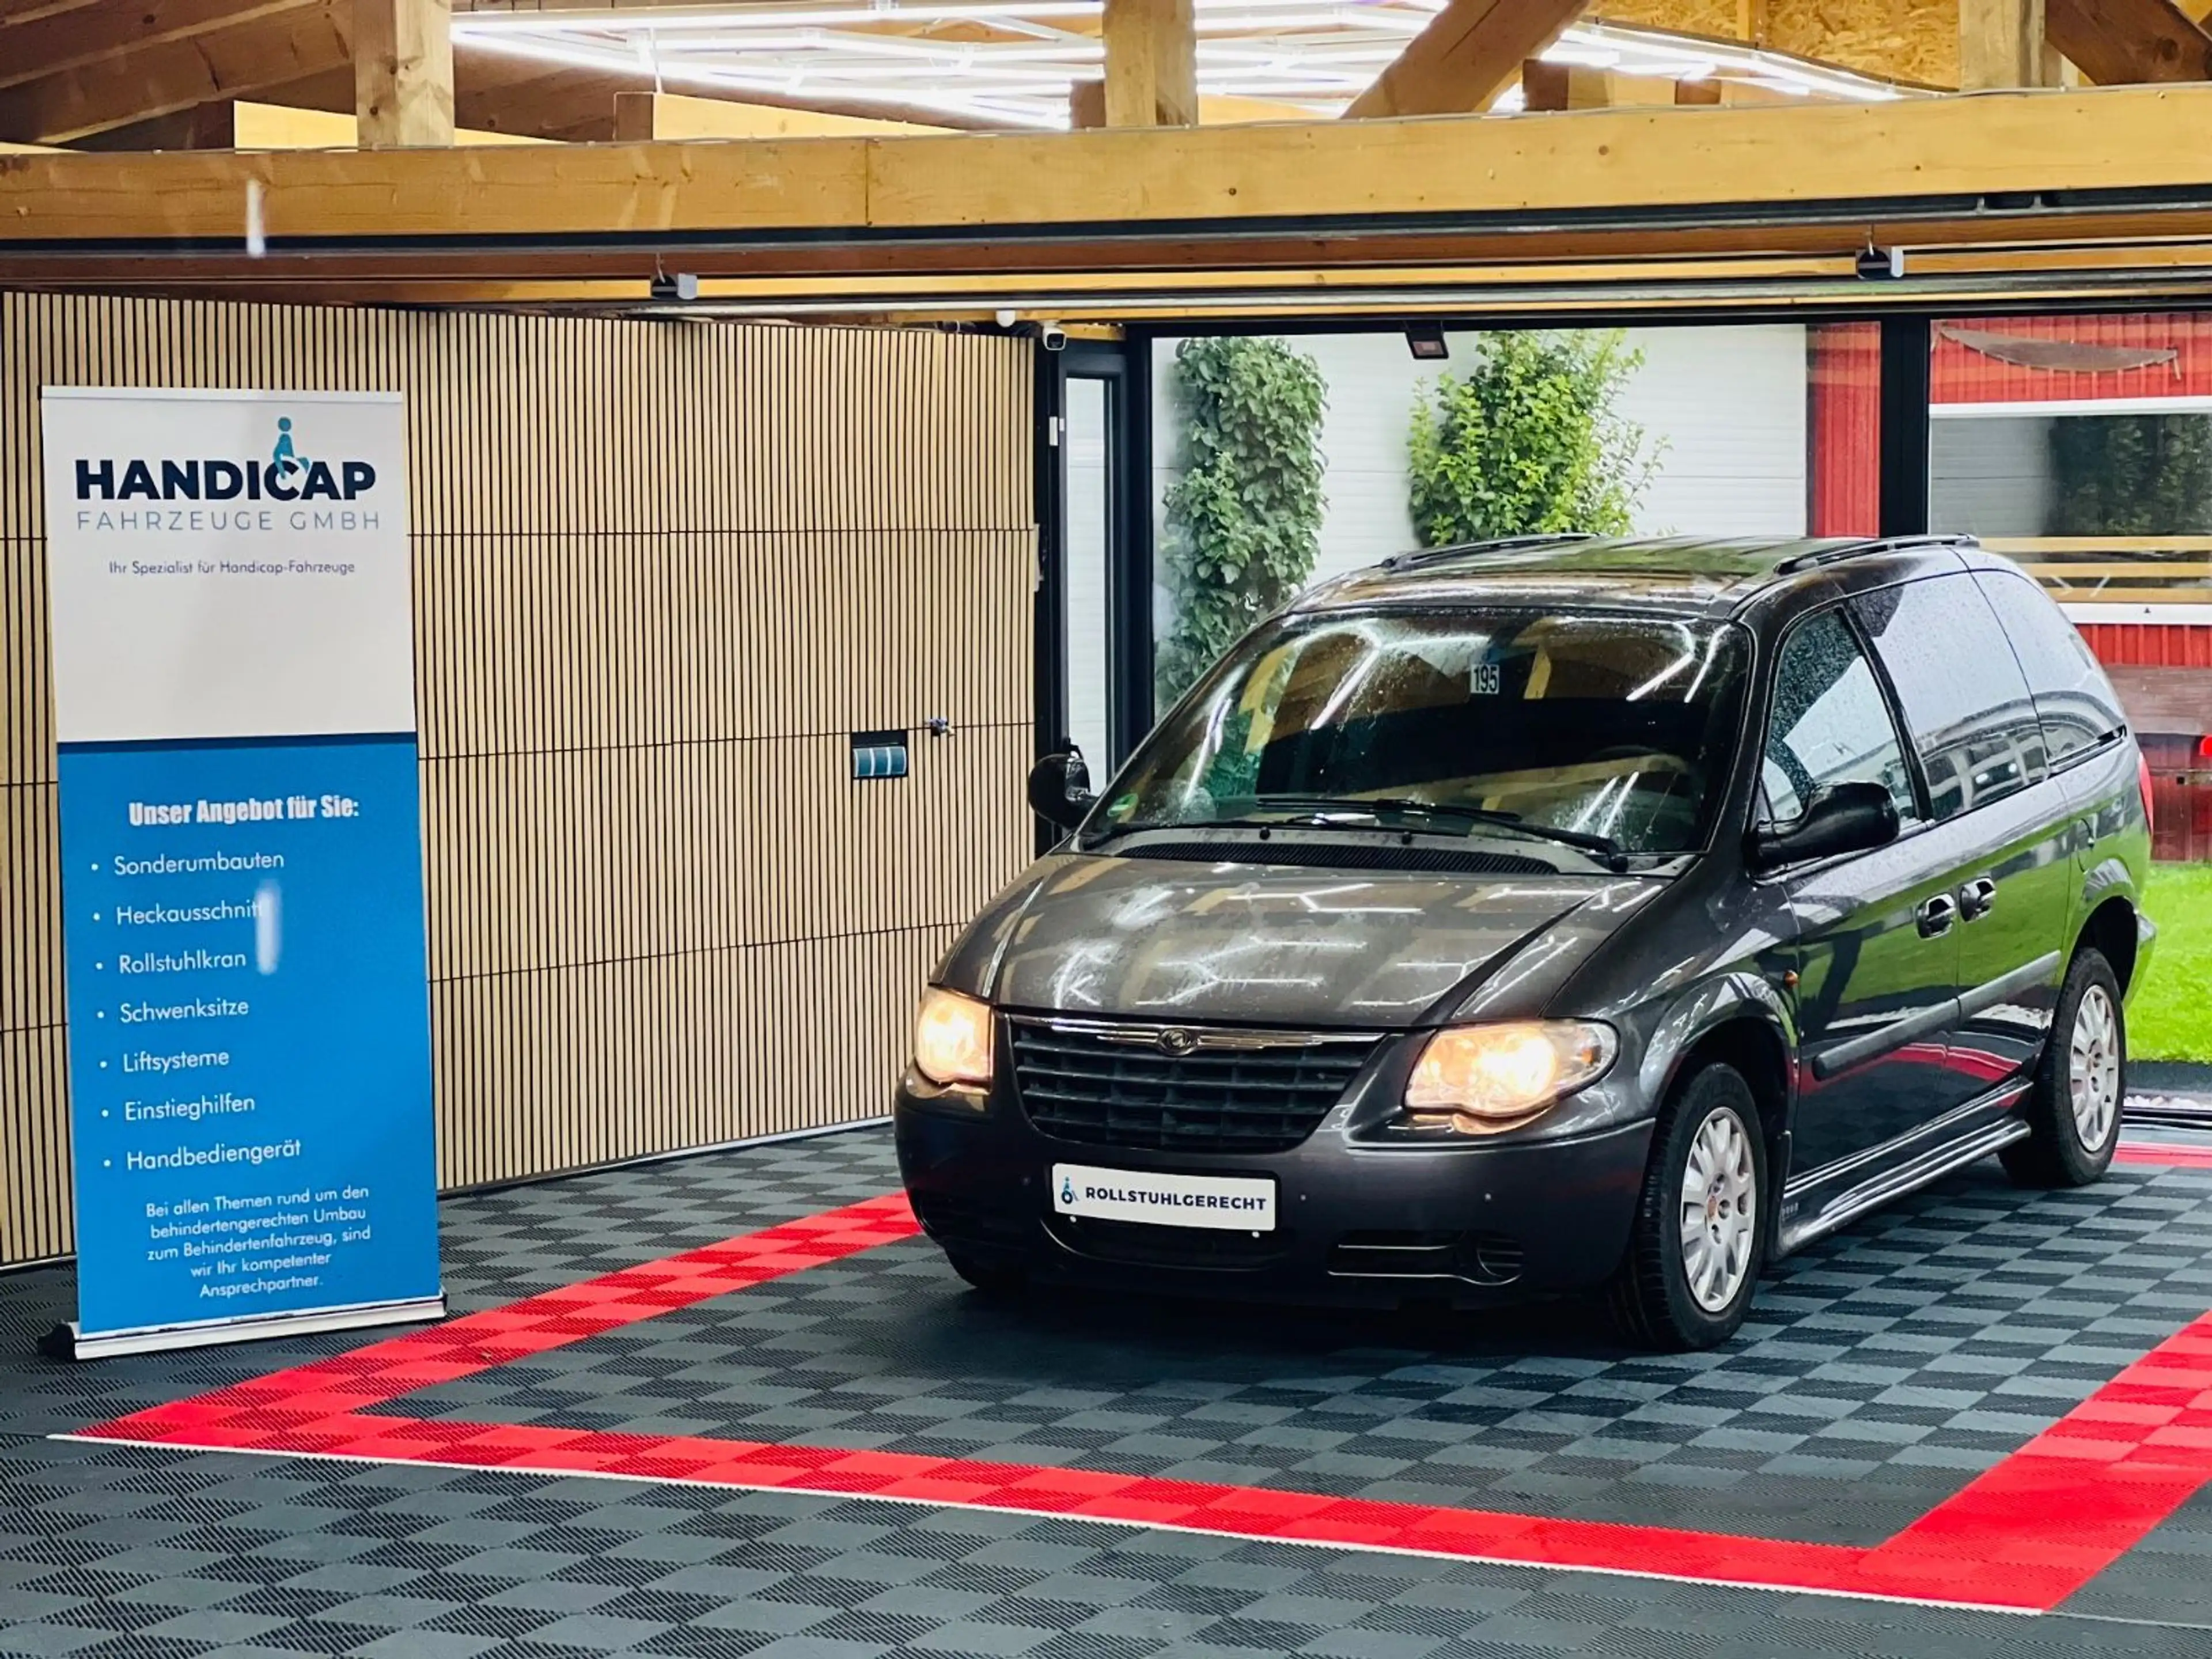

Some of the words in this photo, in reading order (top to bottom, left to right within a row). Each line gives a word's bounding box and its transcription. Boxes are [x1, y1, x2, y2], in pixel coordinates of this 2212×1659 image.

[75, 459, 376, 501] HANDICAP
[77, 510, 272, 531] FAHRZEUGE
[290, 511, 378, 531] GMBH
[109, 561, 127, 574] Ihr
[132, 560, 193, 576] Spezialist
[198, 560, 215, 574] für
[219, 560, 355, 576] Handicap-Fahrzeuge
[1474, 665, 1498, 692] 195
[130, 803, 192, 825] Unser
[196, 798, 283, 824] Angebot
[287, 796, 316, 819] für
[321, 795, 358, 817] Sie:
[114, 851, 284, 876] Sonderumbauten
[119, 949, 246, 974] Rollstuhlkran
[120, 998, 249, 1023] Schwenksitze
[123, 1051, 229, 1074] Liftsysteme
[125, 1092, 255, 1121] Einstieghilfen
[127, 1139, 301, 1171] Handbediengerät
[146, 1203, 168, 1217] Bei
[173, 1199, 209, 1215] allen
[214, 1195, 272, 1211] Themen
[277, 1189, 310, 1205] rund
[315, 1190, 338, 1202] um
[342, 1185, 369, 1199] den
[1085, 1186, 1267, 1210] ROLLSTUHLGERECHT
[150, 1213, 308, 1239] behindertengerechten
[313, 1206, 366, 1223] Umbau
[147, 1248, 179, 1261] zum
[183, 1231, 337, 1257] Behindertenfahrzeug,
[342, 1226, 370, 1241] sind
[191, 1264, 212, 1277] wir
[217, 1260, 236, 1274] Ihr
[241, 1253, 331, 1272] kompetenter
[199, 1275, 323, 1298] Ansprechpartner.
